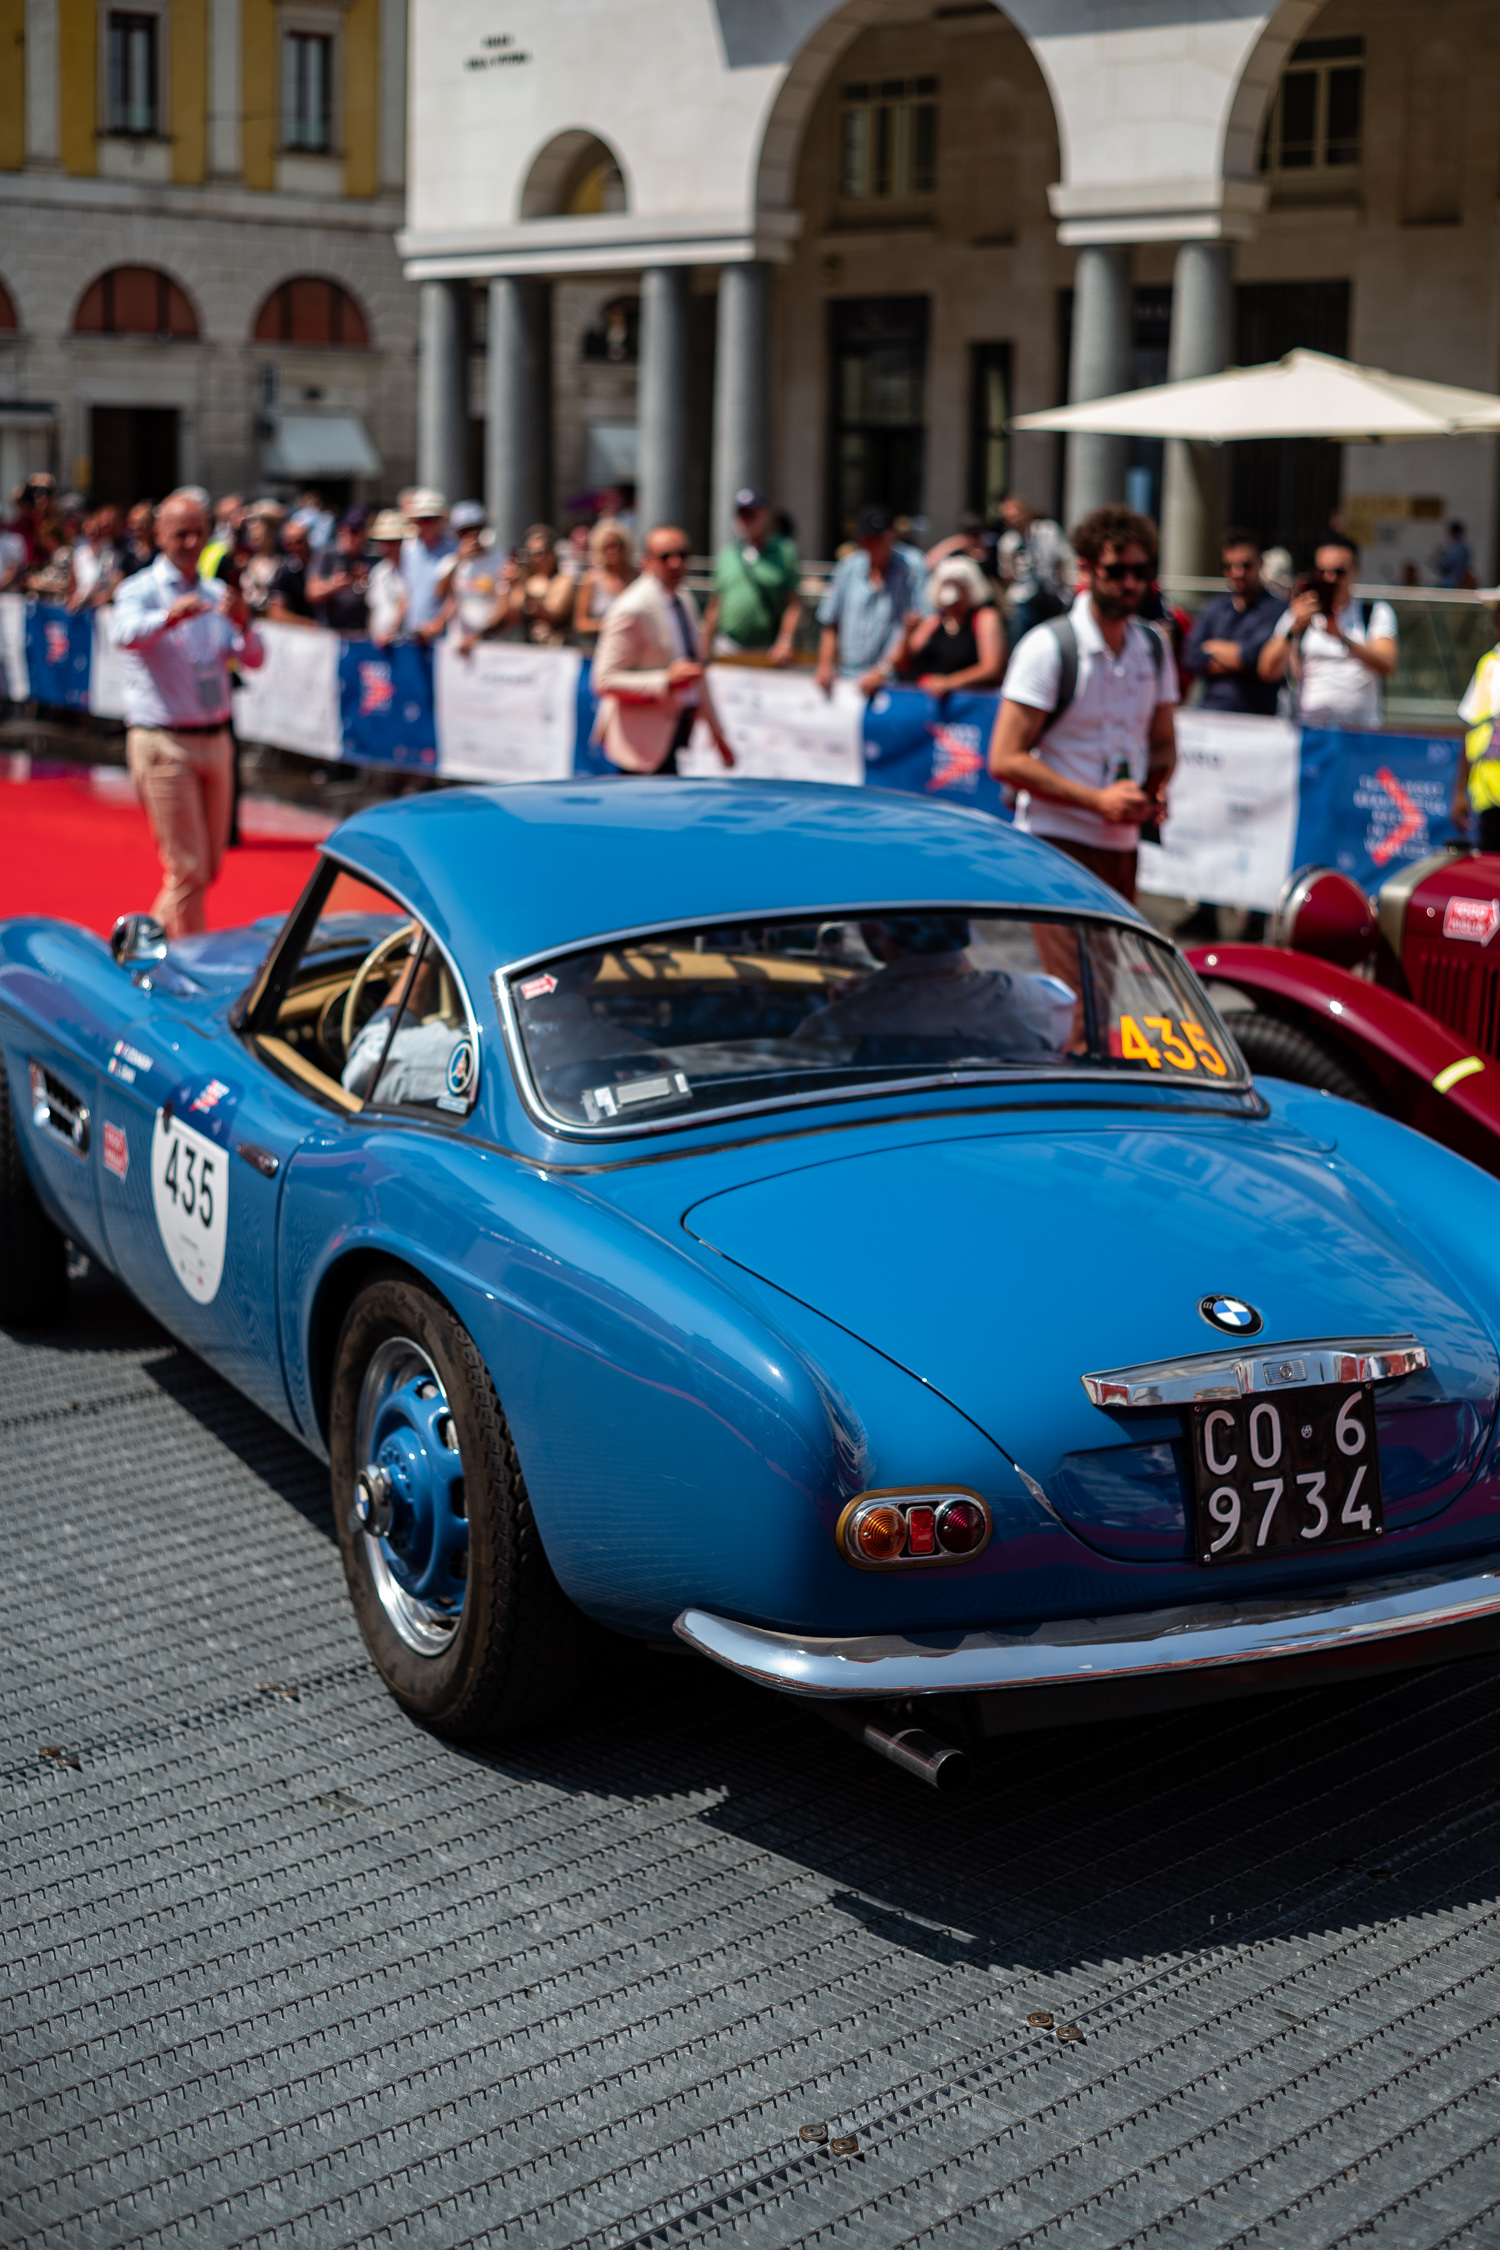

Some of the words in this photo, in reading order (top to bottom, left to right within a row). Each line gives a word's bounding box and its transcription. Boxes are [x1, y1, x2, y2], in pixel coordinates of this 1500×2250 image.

[1120, 1015, 1228, 1076] 435
[165, 1138, 214, 1229] 435
[1204, 1402, 1282, 1475] CO
[1335, 1390, 1366, 1456] 6
[1208, 1465, 1372, 1553] 9734
